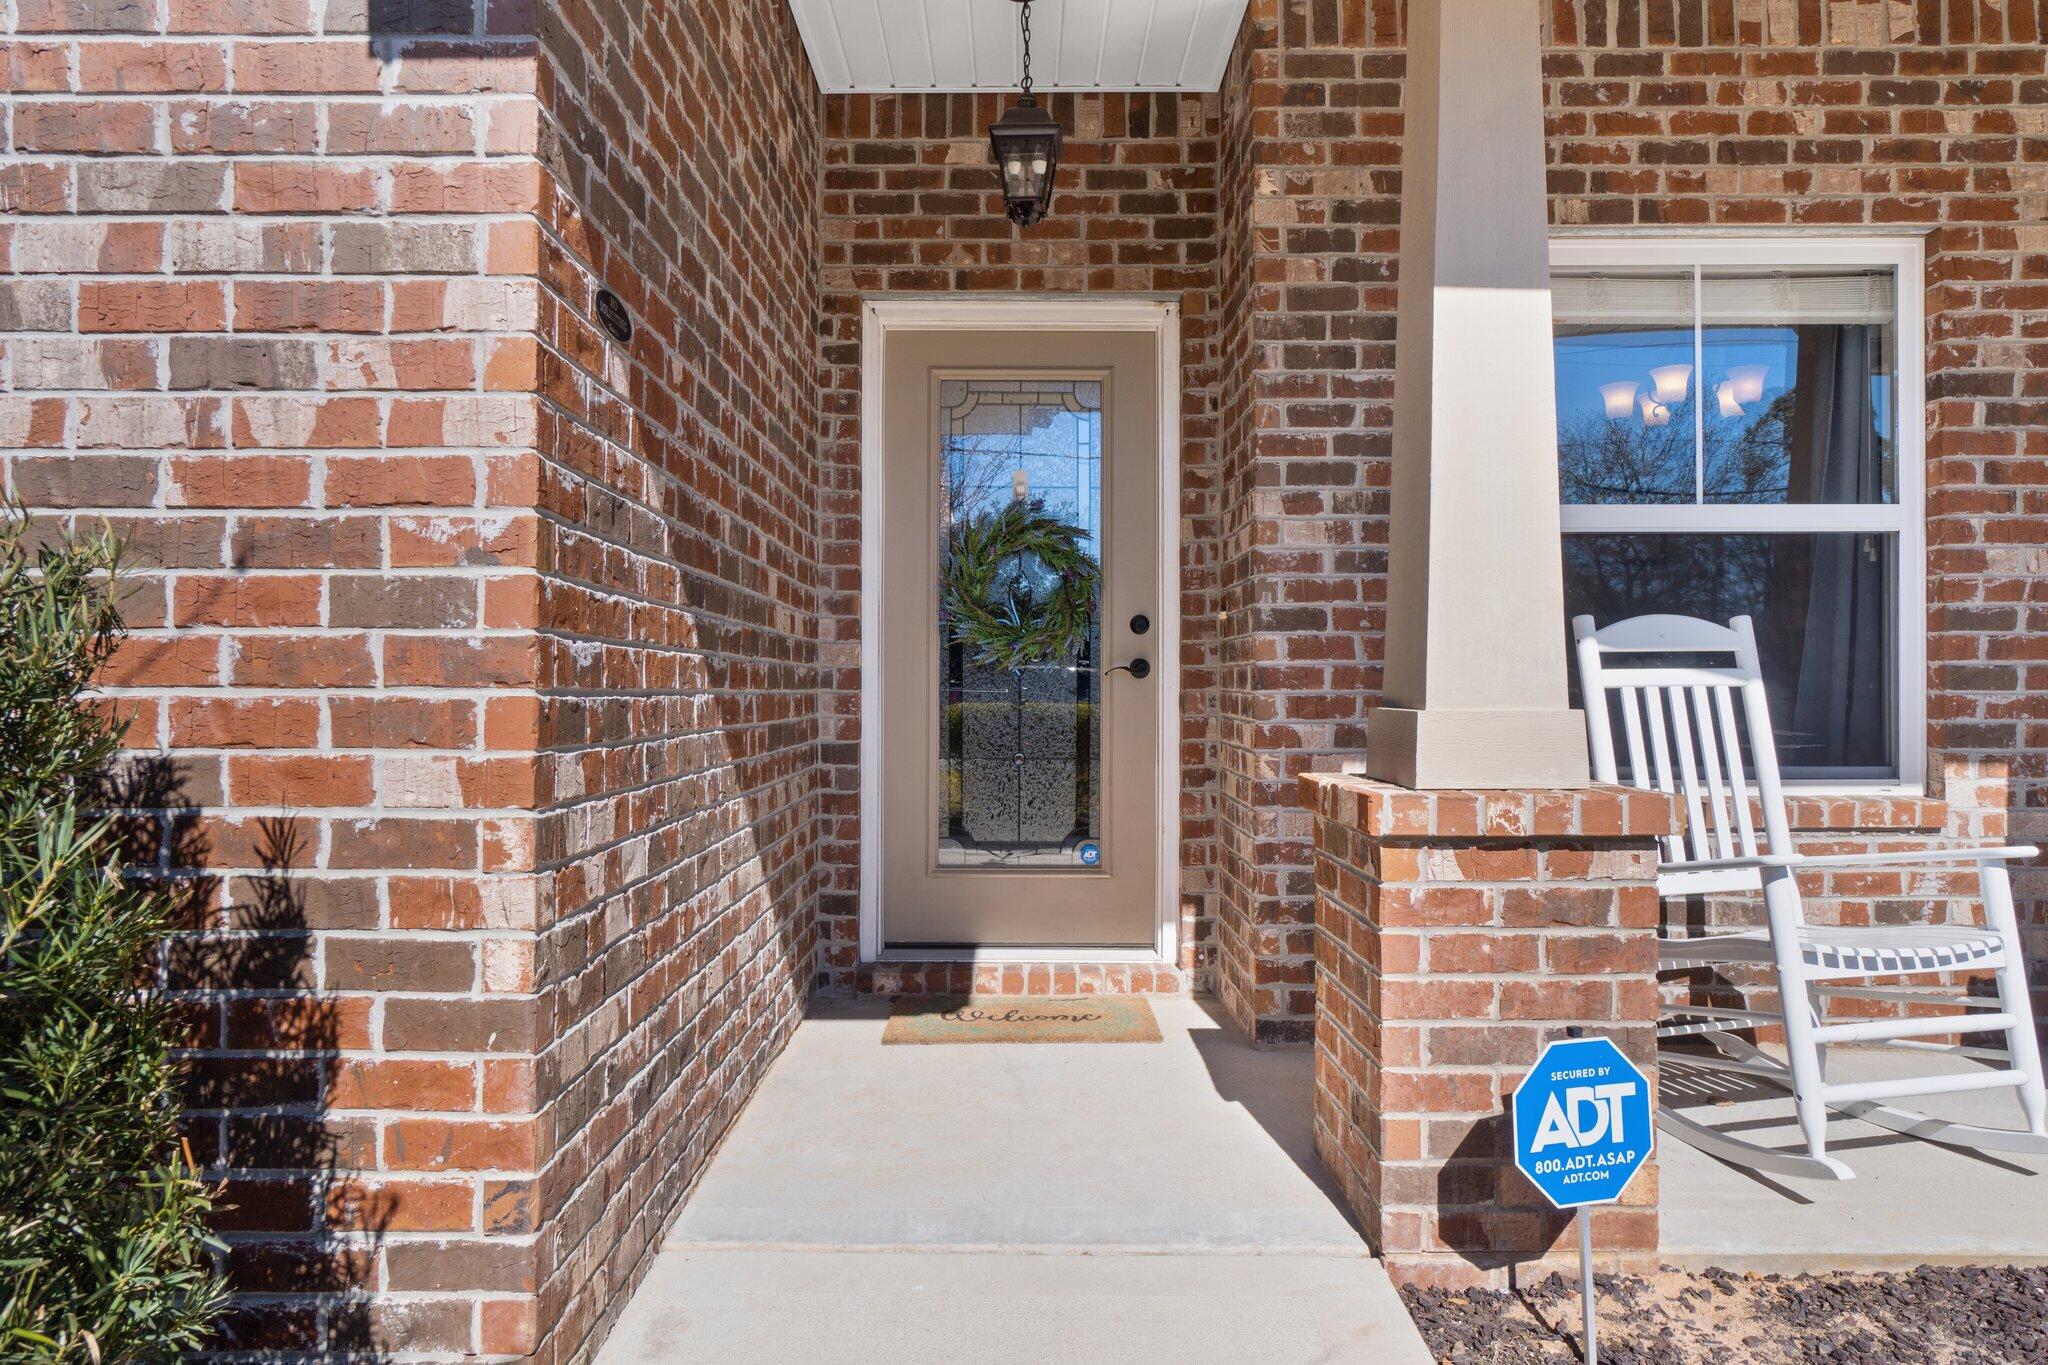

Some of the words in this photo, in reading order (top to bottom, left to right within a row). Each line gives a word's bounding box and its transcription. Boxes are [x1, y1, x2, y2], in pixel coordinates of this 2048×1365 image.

[1083, 850, 1098, 858] ADT
[1550, 1067, 1595, 1081] SECURED
[1598, 1066, 1611, 1076] BY
[1530, 1082, 1636, 1153] ADT
[1535, 1150, 1636, 1174] 800.ADT.ASAP
[1563, 1170, 1610, 1184] ADT.COM
